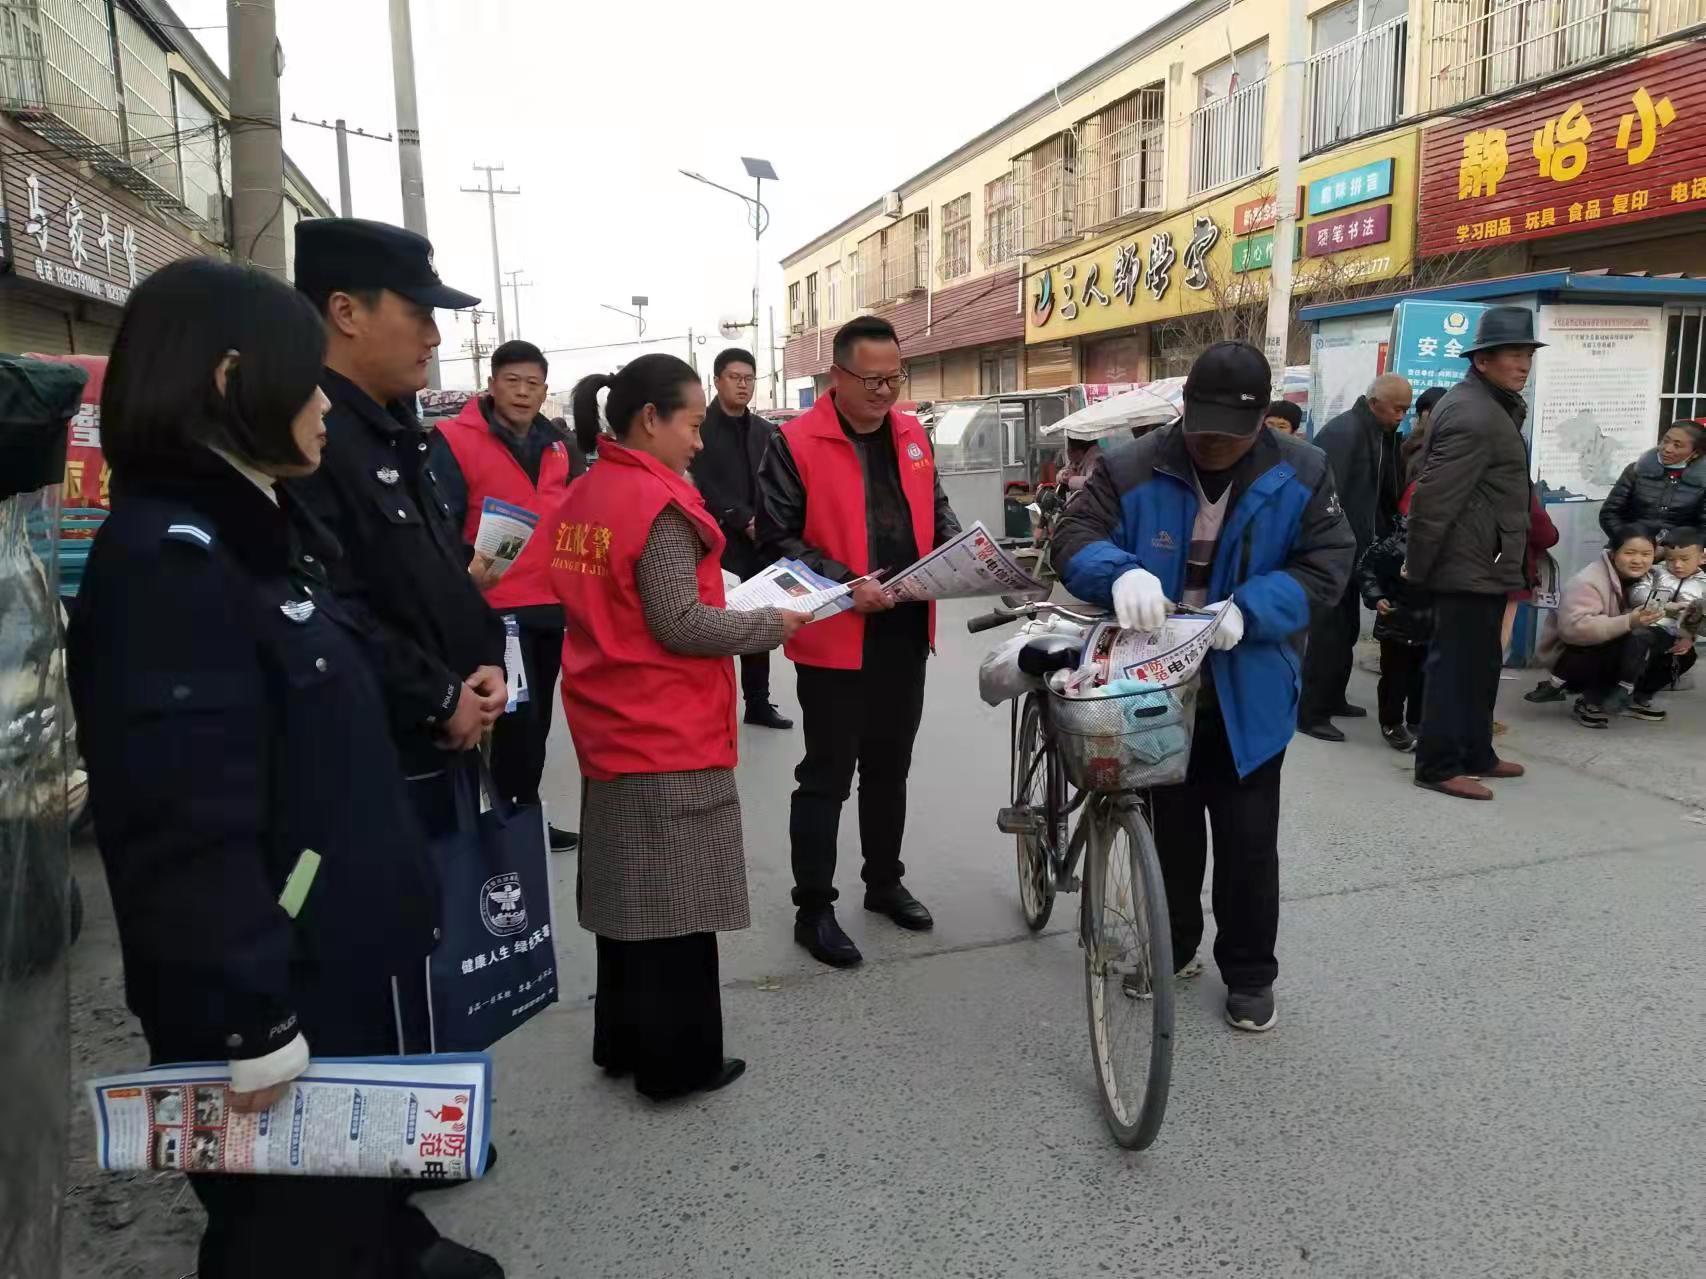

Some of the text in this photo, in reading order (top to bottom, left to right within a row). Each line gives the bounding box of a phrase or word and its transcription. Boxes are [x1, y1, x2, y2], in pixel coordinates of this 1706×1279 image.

[1317, 216, 1374, 246] 硬笔书法
[1456, 217, 1512, 242] 学习用品
[1525, 207, 1556, 230] 玩具
[1568, 199, 1601, 223] 食品
[1612, 190, 1649, 215] 复印
[1417, 336, 1465, 358] 安全
[461, 945, 511, 975] 健康人生
